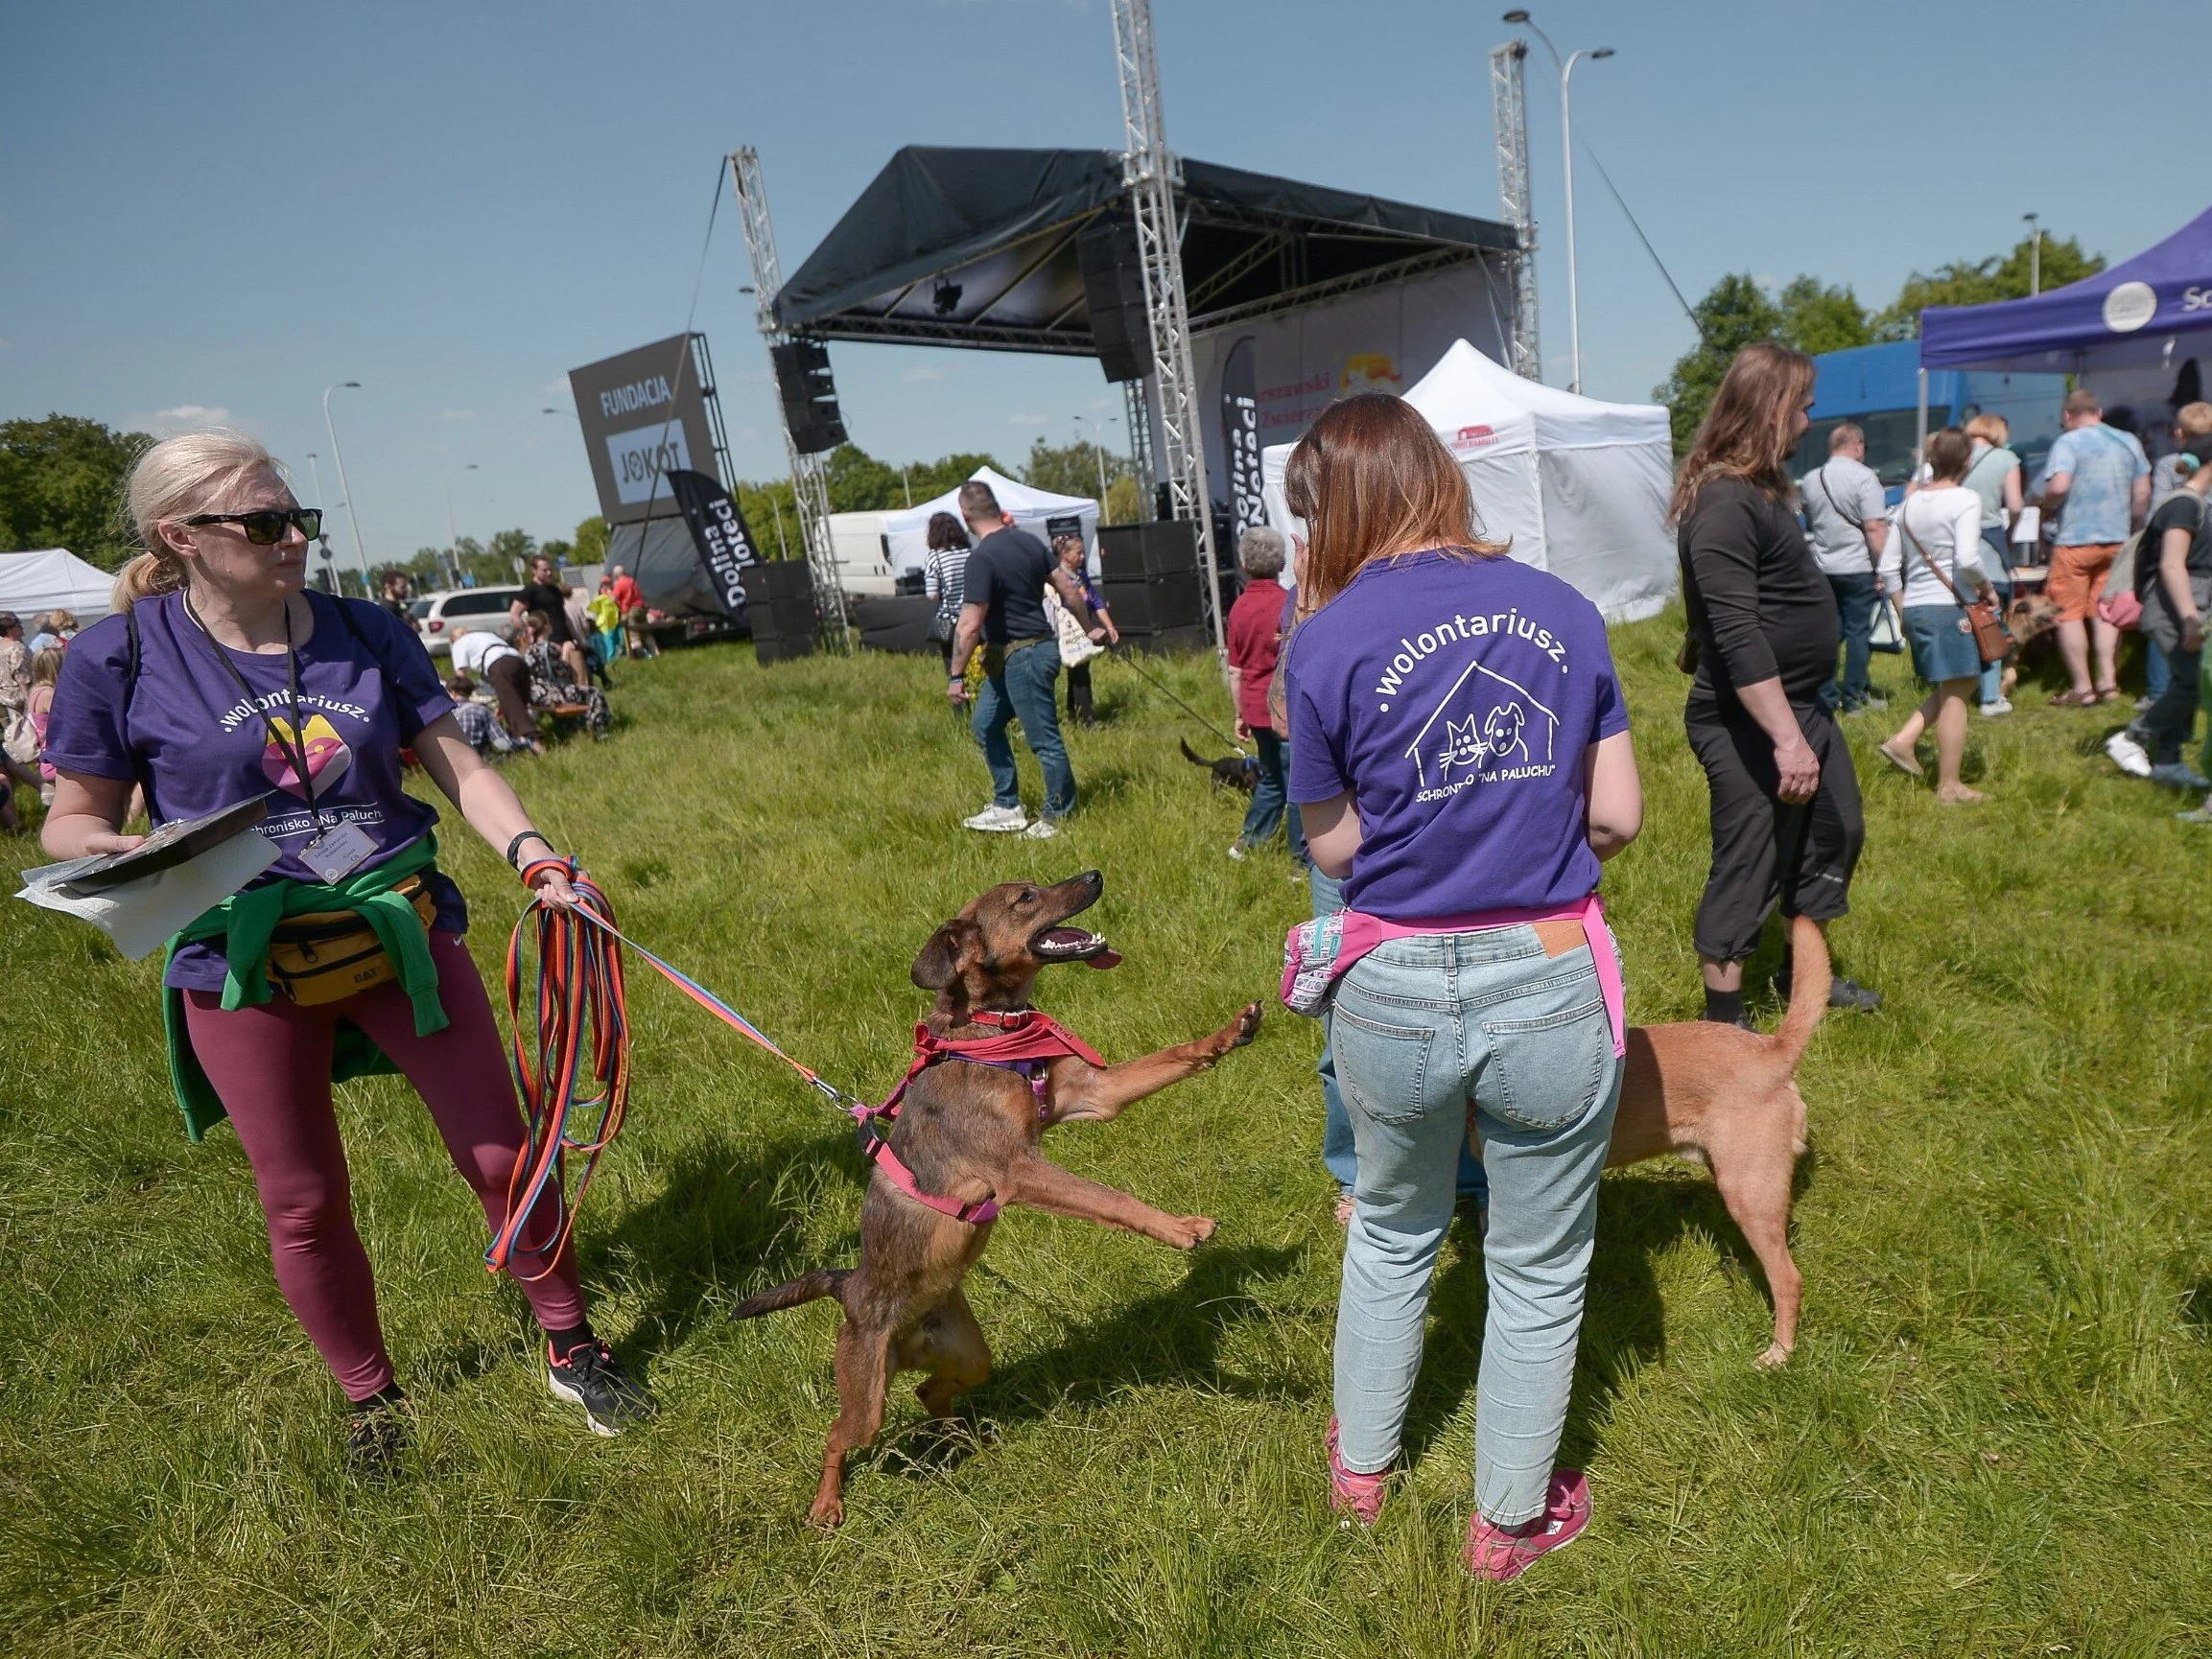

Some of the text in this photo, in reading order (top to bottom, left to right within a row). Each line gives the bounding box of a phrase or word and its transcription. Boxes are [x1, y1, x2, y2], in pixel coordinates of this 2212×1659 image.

[600, 375, 671, 417] FUNDACJA
[621, 441, 682, 483] JOKOT
[1235, 396, 1264, 526] Noteci
[704, 525, 746, 608] Dolina
[1376, 607, 1566, 696] wolontariusz
[353, 968, 378, 983] CAT
